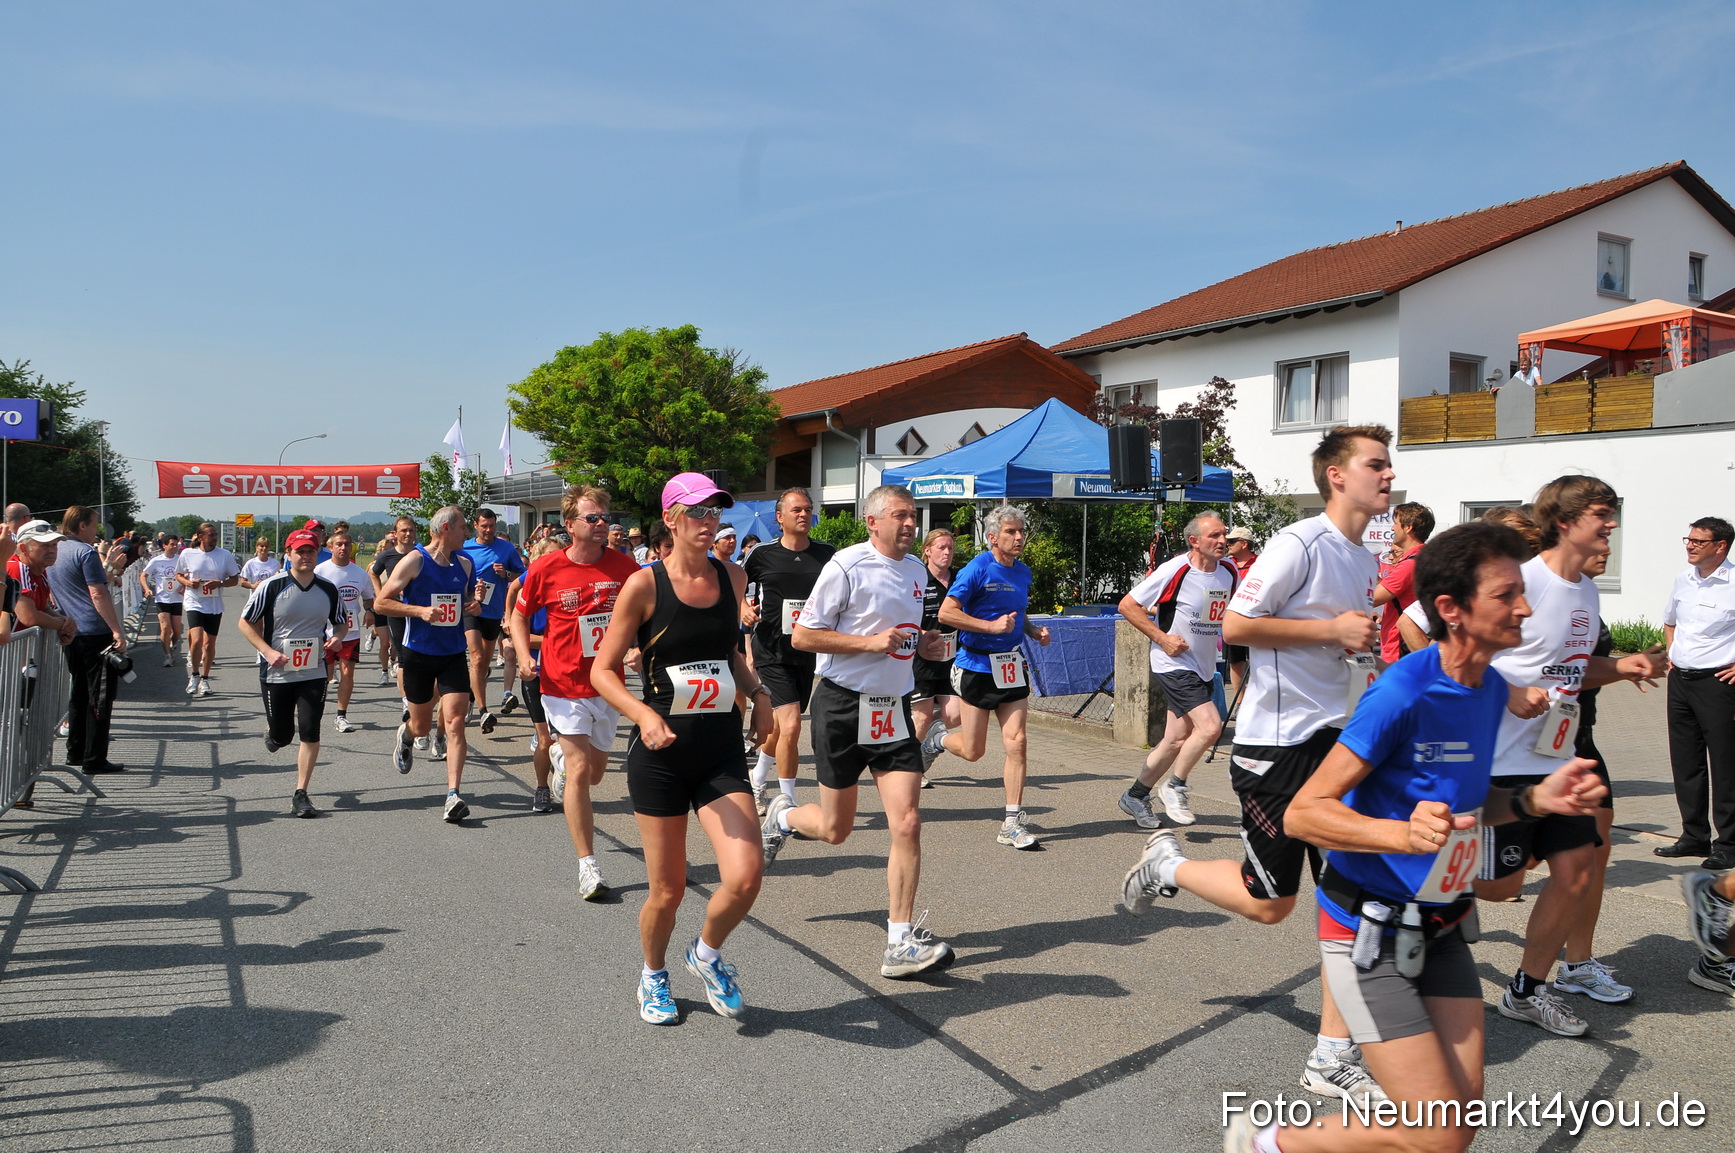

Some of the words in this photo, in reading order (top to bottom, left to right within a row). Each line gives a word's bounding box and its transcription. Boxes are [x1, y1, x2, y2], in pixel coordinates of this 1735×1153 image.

[219, 475, 367, 494] START+ZIEL
[916, 482, 942, 494] Neumarkter
[168, 581, 173, 590] 3
[1209, 600, 1226, 621] 62
[346, 616, 353, 629] 5
[592, 626, 609, 651] 2
[292, 648, 312, 668] 67
[679, 663, 708, 673] MEYER
[1001, 663, 1016, 683] 13
[687, 678, 720, 709] 72
[870, 709, 895, 740] 54
[1552, 718, 1571, 750] 8
[1440, 838, 1477, 893] 92
